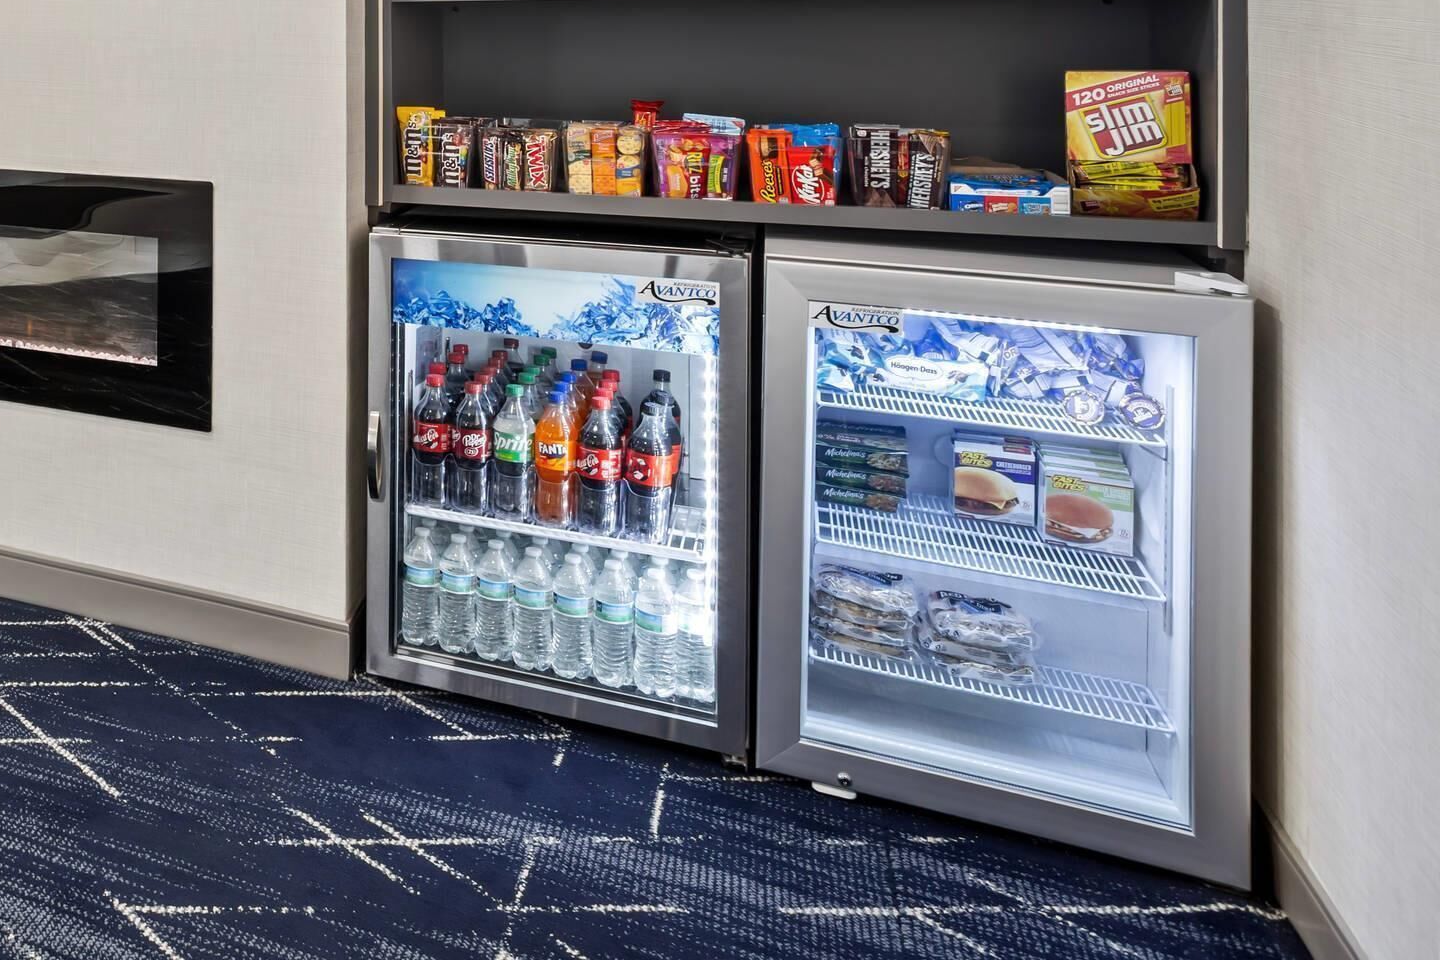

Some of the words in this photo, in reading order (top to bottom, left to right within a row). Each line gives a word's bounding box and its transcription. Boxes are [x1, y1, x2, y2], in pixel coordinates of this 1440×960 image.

[1072, 88, 1106, 106] 120
[1106, 74, 1160, 93] ORIGINAL
[526, 142, 545, 186] TWIX
[687, 152, 703, 174] RITZ
[870, 131, 890, 189] HERSHEY'S
[689, 175, 701, 199] bits
[760, 159, 777, 203] Reese's
[910, 153, 934, 209] HERSHEY'S
[638, 280, 717, 302] AVANTCO
[811, 305, 900, 329] AVANTCO
[494, 432, 532, 450] Sprite
[825, 447, 866, 458] Michelina's
[960, 451, 986, 460] FAST
[826, 468, 867, 480] Michelina's
[824, 487, 865, 499] Michelina's
